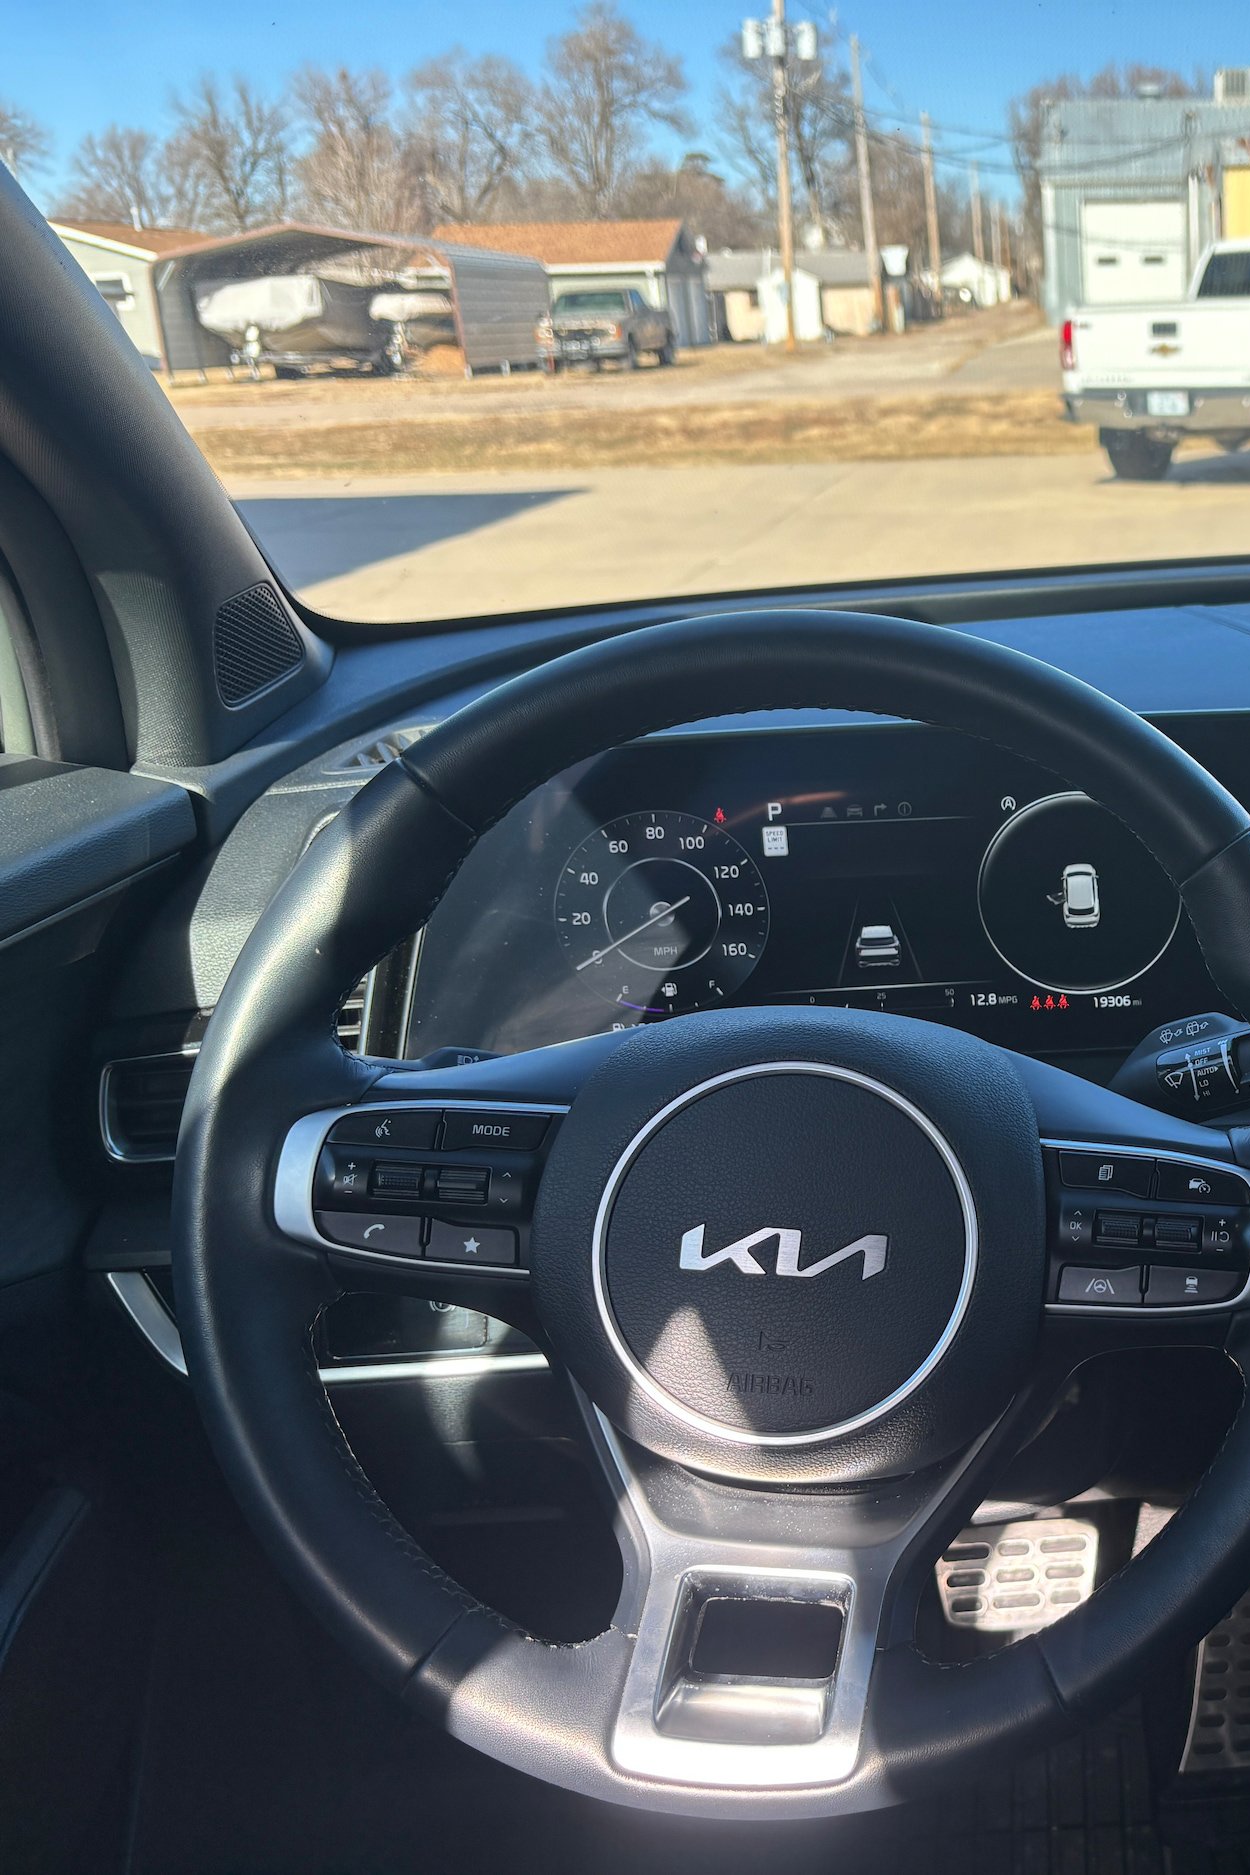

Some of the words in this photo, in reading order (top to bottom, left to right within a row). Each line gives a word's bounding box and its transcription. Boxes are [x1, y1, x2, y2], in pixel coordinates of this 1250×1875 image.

[767, 802, 782, 821] P
[645, 826, 665, 840] 80
[608, 840, 629, 854] 60
[679, 836, 705, 850] 100
[713, 864, 740, 879] 120
[579, 872, 599, 886] 40
[727, 902, 754, 917] 140
[571, 912, 591, 926] 20
[653, 946, 678, 957] MPH
[721, 942, 748, 957] 160
[622, 985, 629, 994] E
[876, 992, 887, 1000] 25
[970, 993, 997, 1007] 12.8
[998, 996, 1018, 1005] MPG
[1094, 995, 1131, 1009] 19306
[1132, 998, 1143, 1007] mi
[1197, 1066, 1215, 1077] AUTO
[1199, 1079, 1209, 1088] LO
[472, 1124, 511, 1137] MODE
[1069, 1220, 1083, 1231] OK
[679, 1223, 888, 1281] KIA
[727, 1372, 816, 1396] AIRBAG
